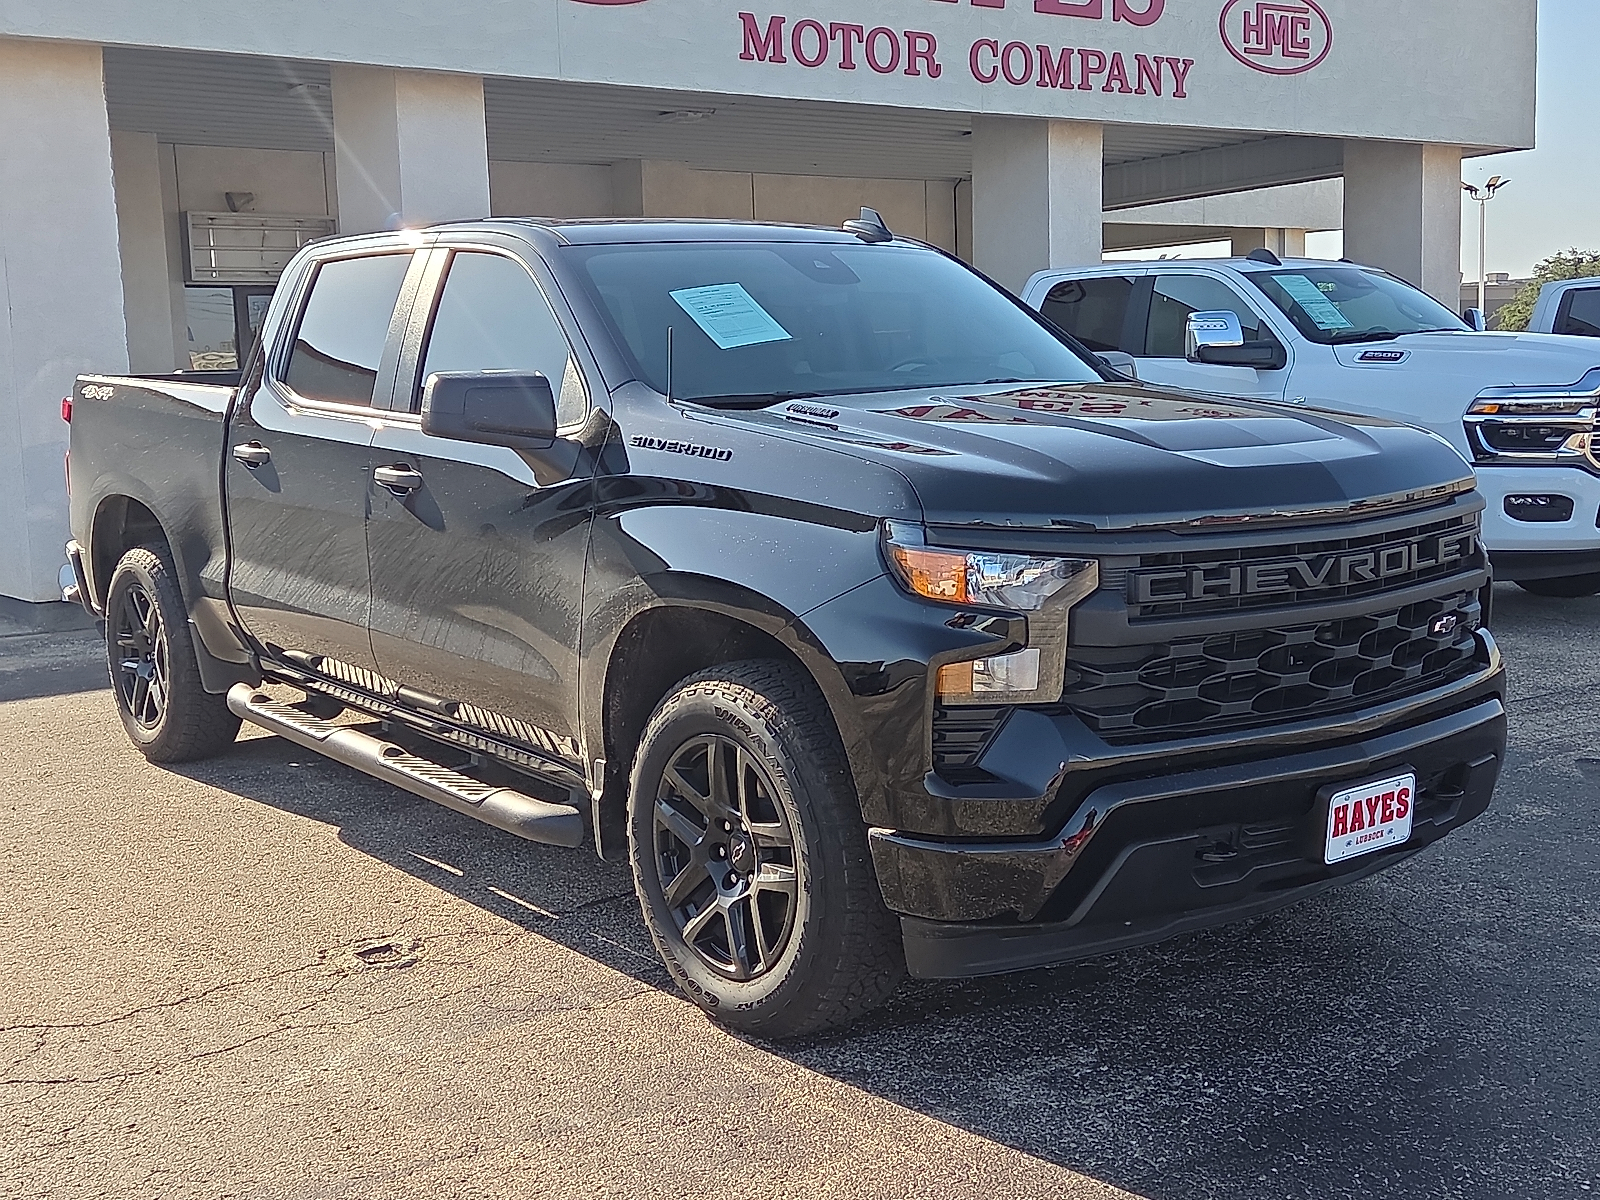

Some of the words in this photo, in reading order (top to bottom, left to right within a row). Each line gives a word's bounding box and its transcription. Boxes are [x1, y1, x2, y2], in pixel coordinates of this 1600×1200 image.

[738, 11, 941, 79] MOTOR
[969, 38, 1194, 98] COMPANY
[1243, 2, 1310, 58] HMC
[628, 434, 733, 462] SILVERADO
[1138, 534, 1476, 604] CHEVROLET
[1332, 787, 1410, 838] HAYES
[1355, 829, 1385, 845] LUBBOCK
